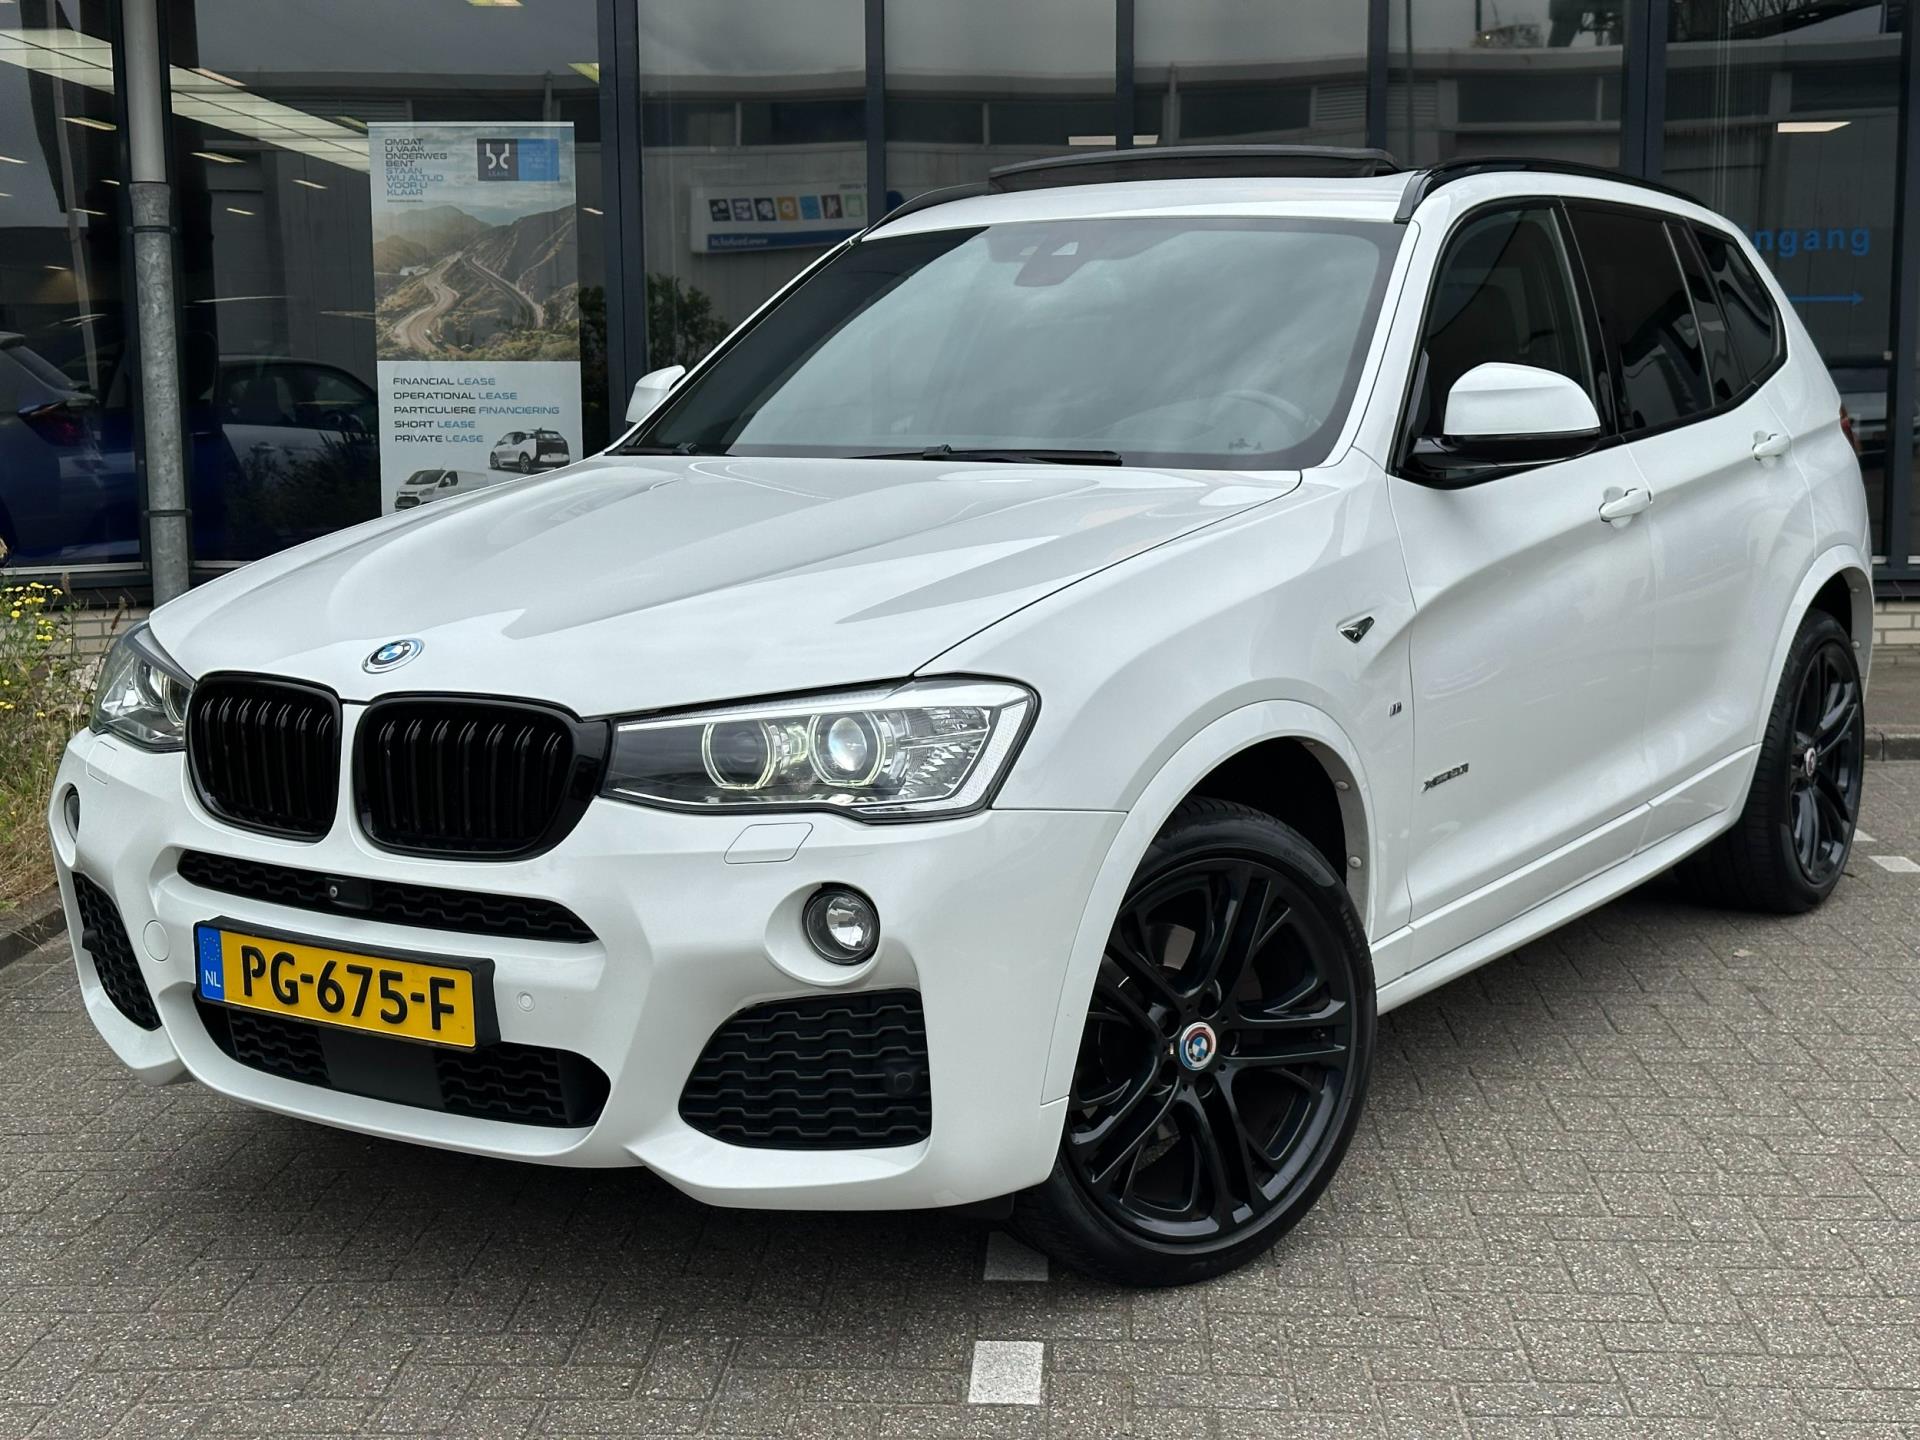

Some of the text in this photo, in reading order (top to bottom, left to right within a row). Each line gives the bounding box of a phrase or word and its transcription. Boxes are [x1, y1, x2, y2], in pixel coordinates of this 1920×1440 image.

[385, 138, 424, 146] OMDAT
[1744, 225, 1870, 257] ngang
[393, 377, 496, 386] FINANCIAL LEASE
[393, 392, 518, 400] OPERATIONAL LEASE
[394, 406, 560, 415] PARTICULIERE FINANCIERING
[394, 420, 434, 428] SHORT
[395, 435, 484, 443] PRIVATE LEASE
[205, 945, 456, 1031] NL PG-675-F
